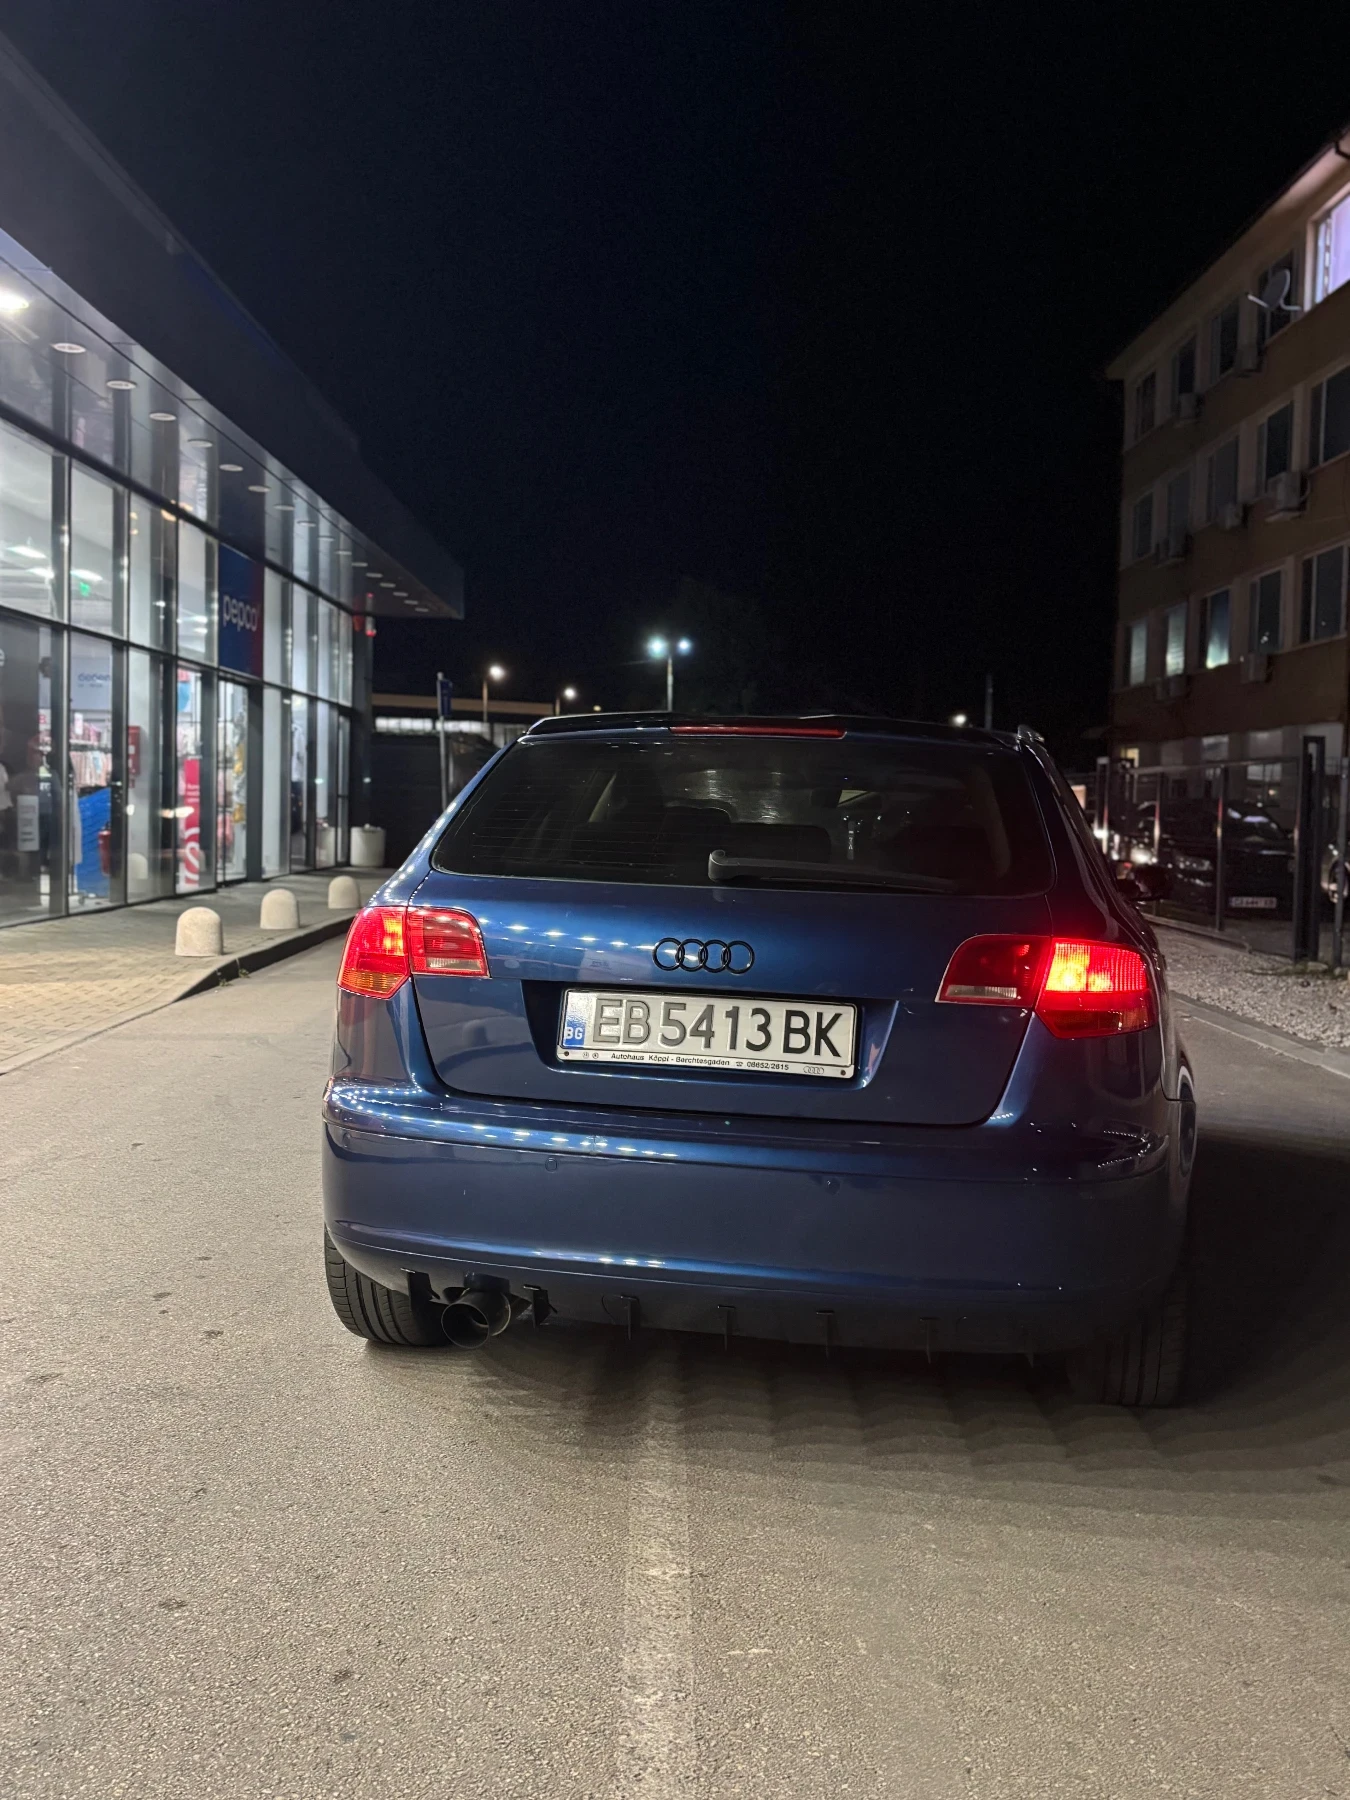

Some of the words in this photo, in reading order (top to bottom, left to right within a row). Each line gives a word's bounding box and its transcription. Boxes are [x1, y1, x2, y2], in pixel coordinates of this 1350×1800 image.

[223, 595, 258, 632] pepco
[564, 1026, 584, 1040] BG
[611, 1052, 645, 1061] Autohaus
[676, 1056, 730, 1067] Berchtesgaden
